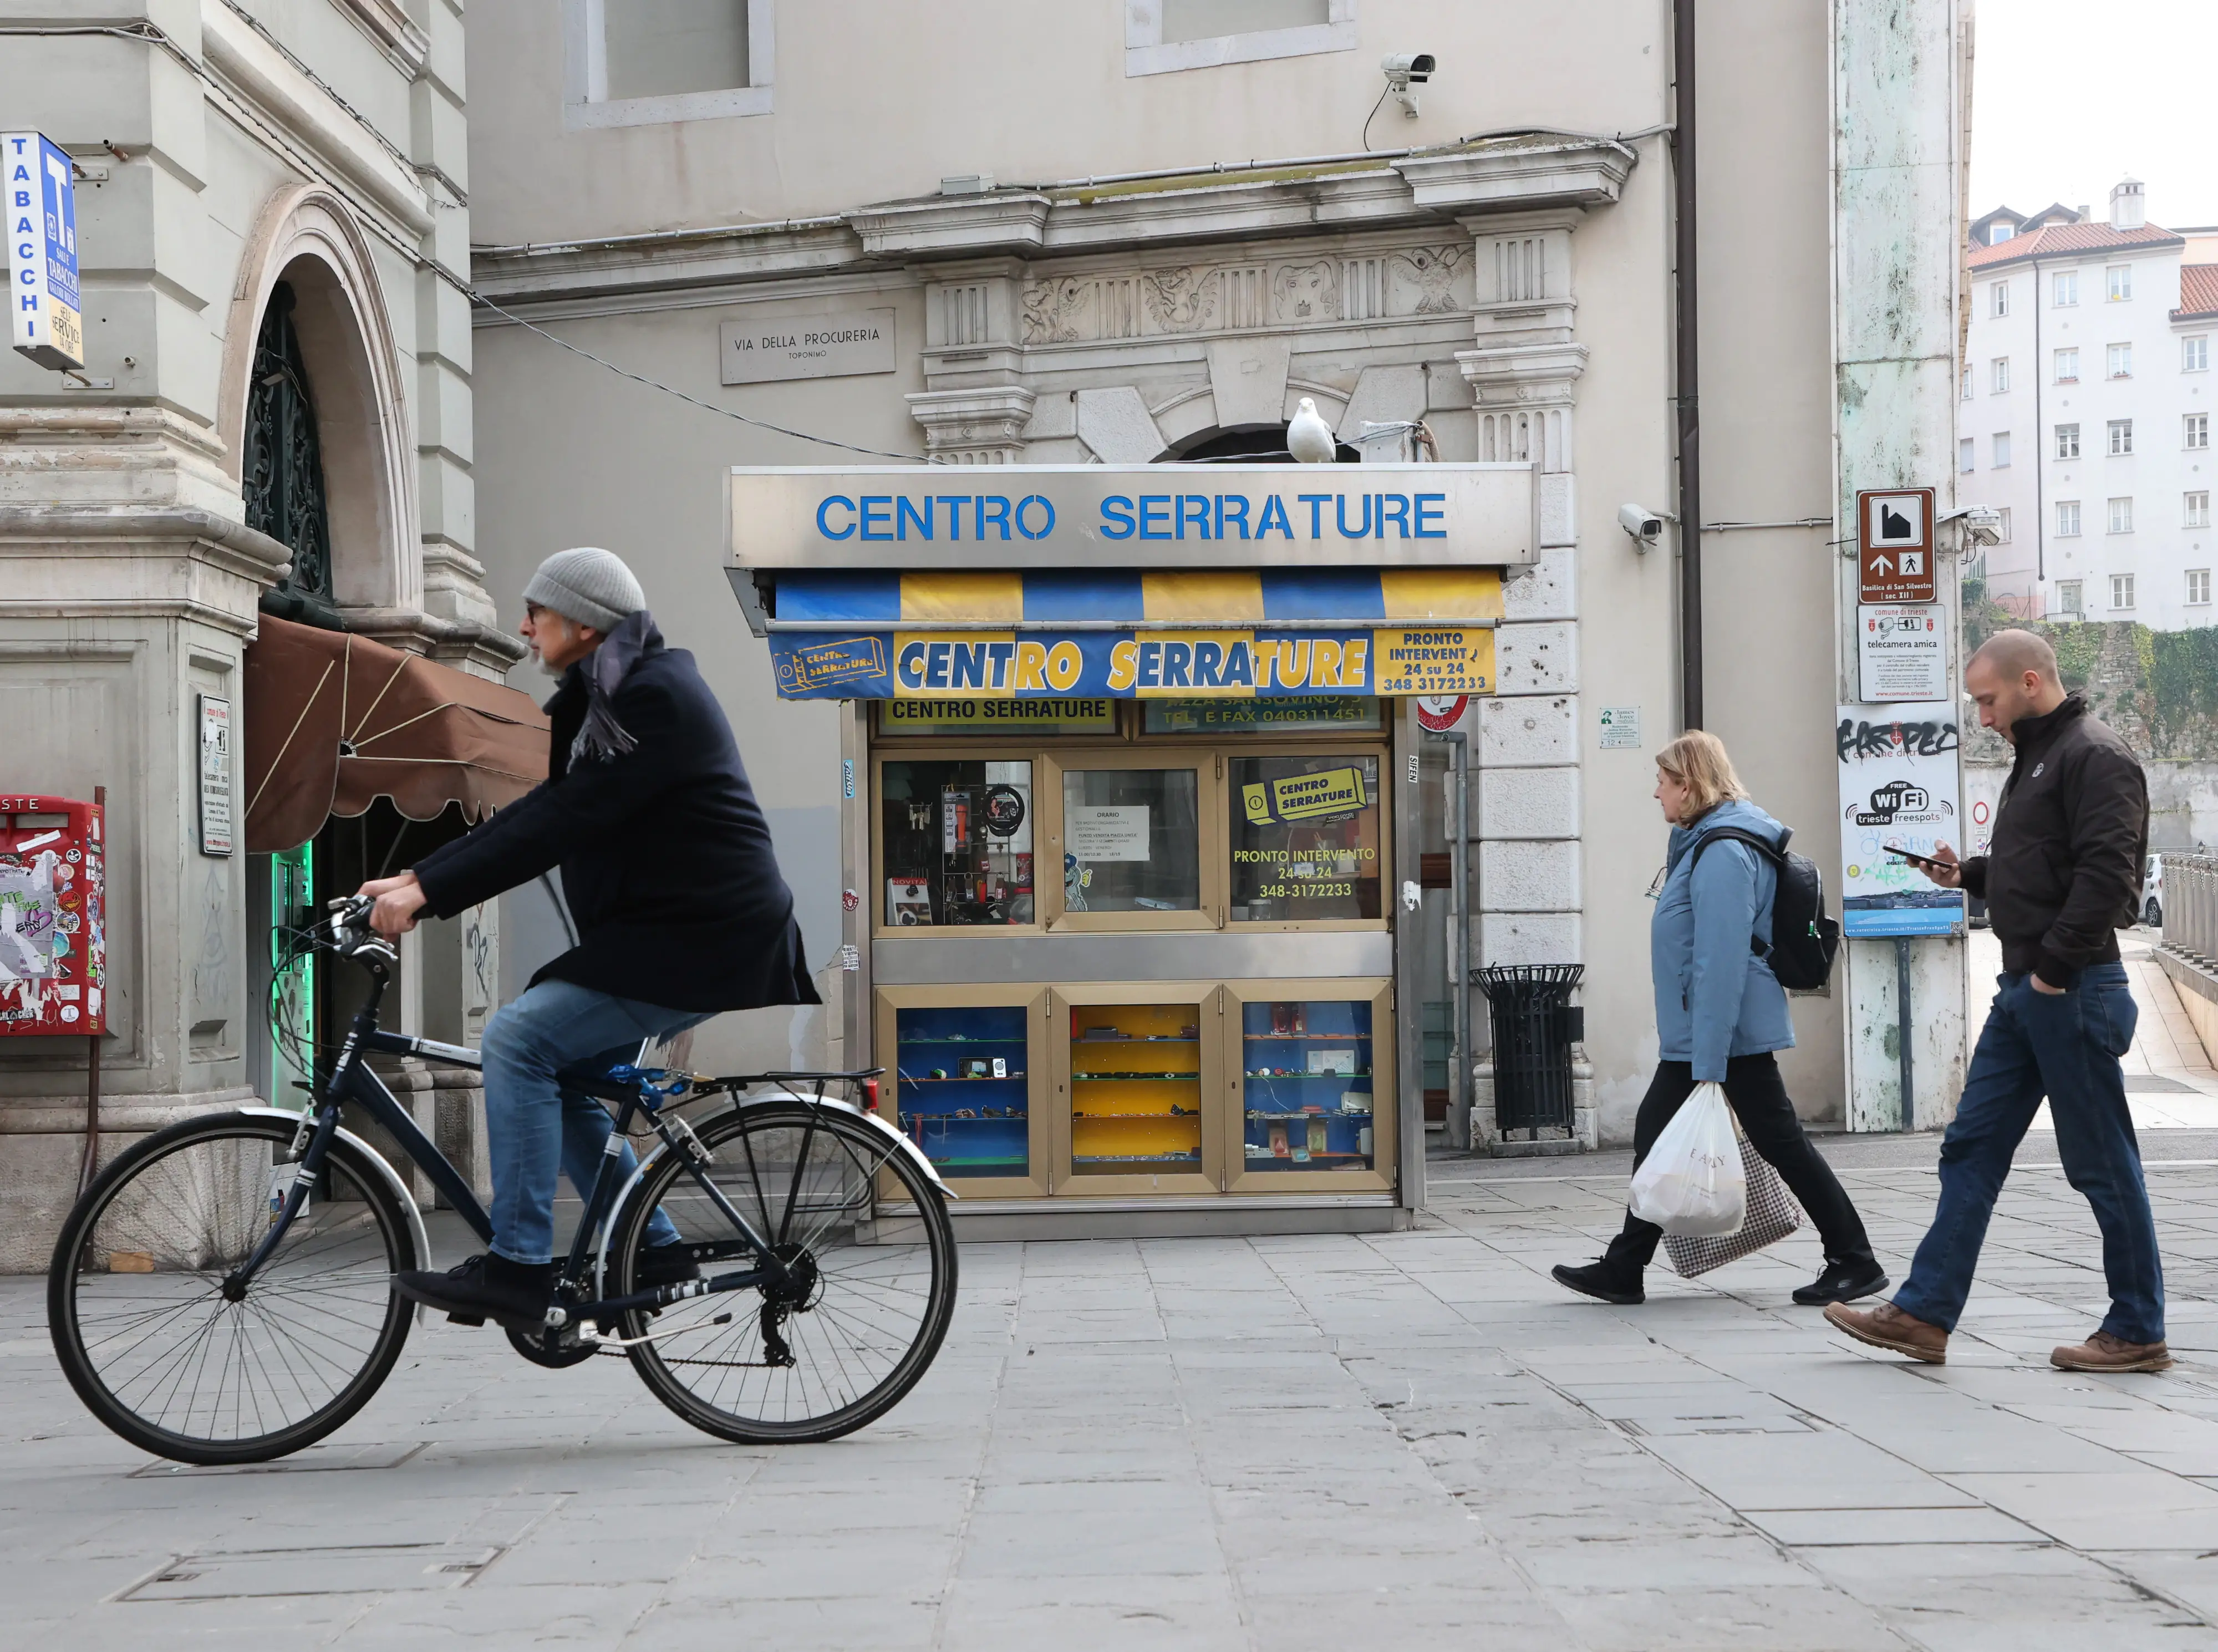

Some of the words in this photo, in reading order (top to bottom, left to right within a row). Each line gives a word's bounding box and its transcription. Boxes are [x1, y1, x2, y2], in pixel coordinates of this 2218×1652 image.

[11, 139, 37, 337] TABACCHI
[48, 257, 78, 294] TABACCHI
[60, 306, 70, 322] SELF
[52, 316, 80, 343] SERVICE
[734, 339, 754, 351] VIA
[762, 336, 797, 349] DELLA
[805, 328, 881, 346] PROCURERIA
[788, 350, 827, 359] TOPONIMO
[816, 495, 1056, 541] CENTRO
[1100, 493, 1447, 541] SERRATURE
[1403, 632, 1463, 645] PRONTO
[1868, 640, 1912, 648] telecamera
[1914, 639, 1937, 648] amica
[897, 640, 1083, 691] CENTRO
[1106, 638, 1369, 691] SERRATURE
[1404, 663, 1422, 675] 24
[1426, 667, 1442, 675] su
[1447, 662, 1464, 675] 24
[1383, 678, 1413, 691] 348
[1417, 676, 1486, 690] 3172233
[892, 700, 975, 719] CENTRO
[983, 700, 1106, 718] SERRATURE
[1205, 711, 1216, 723] E
[1223, 710, 1256, 722] FAX
[1262, 708, 1365, 721] 040311451
[1409, 757, 1417, 781] SIFEN
[1279, 779, 1329, 795] CENTRO
[1282, 789, 1353, 810] SERRATURE
[1858, 814, 1890, 823] trieste
[1895, 812, 1940, 824] freespots
[1234, 850, 1289, 862] PRONTO
[1293, 848, 1376, 862] INTERVENTO
[1278, 867, 1294, 879] 24
[1317, 867, 1332, 878] 24
[1259, 883, 1352, 897] 348-3172233
